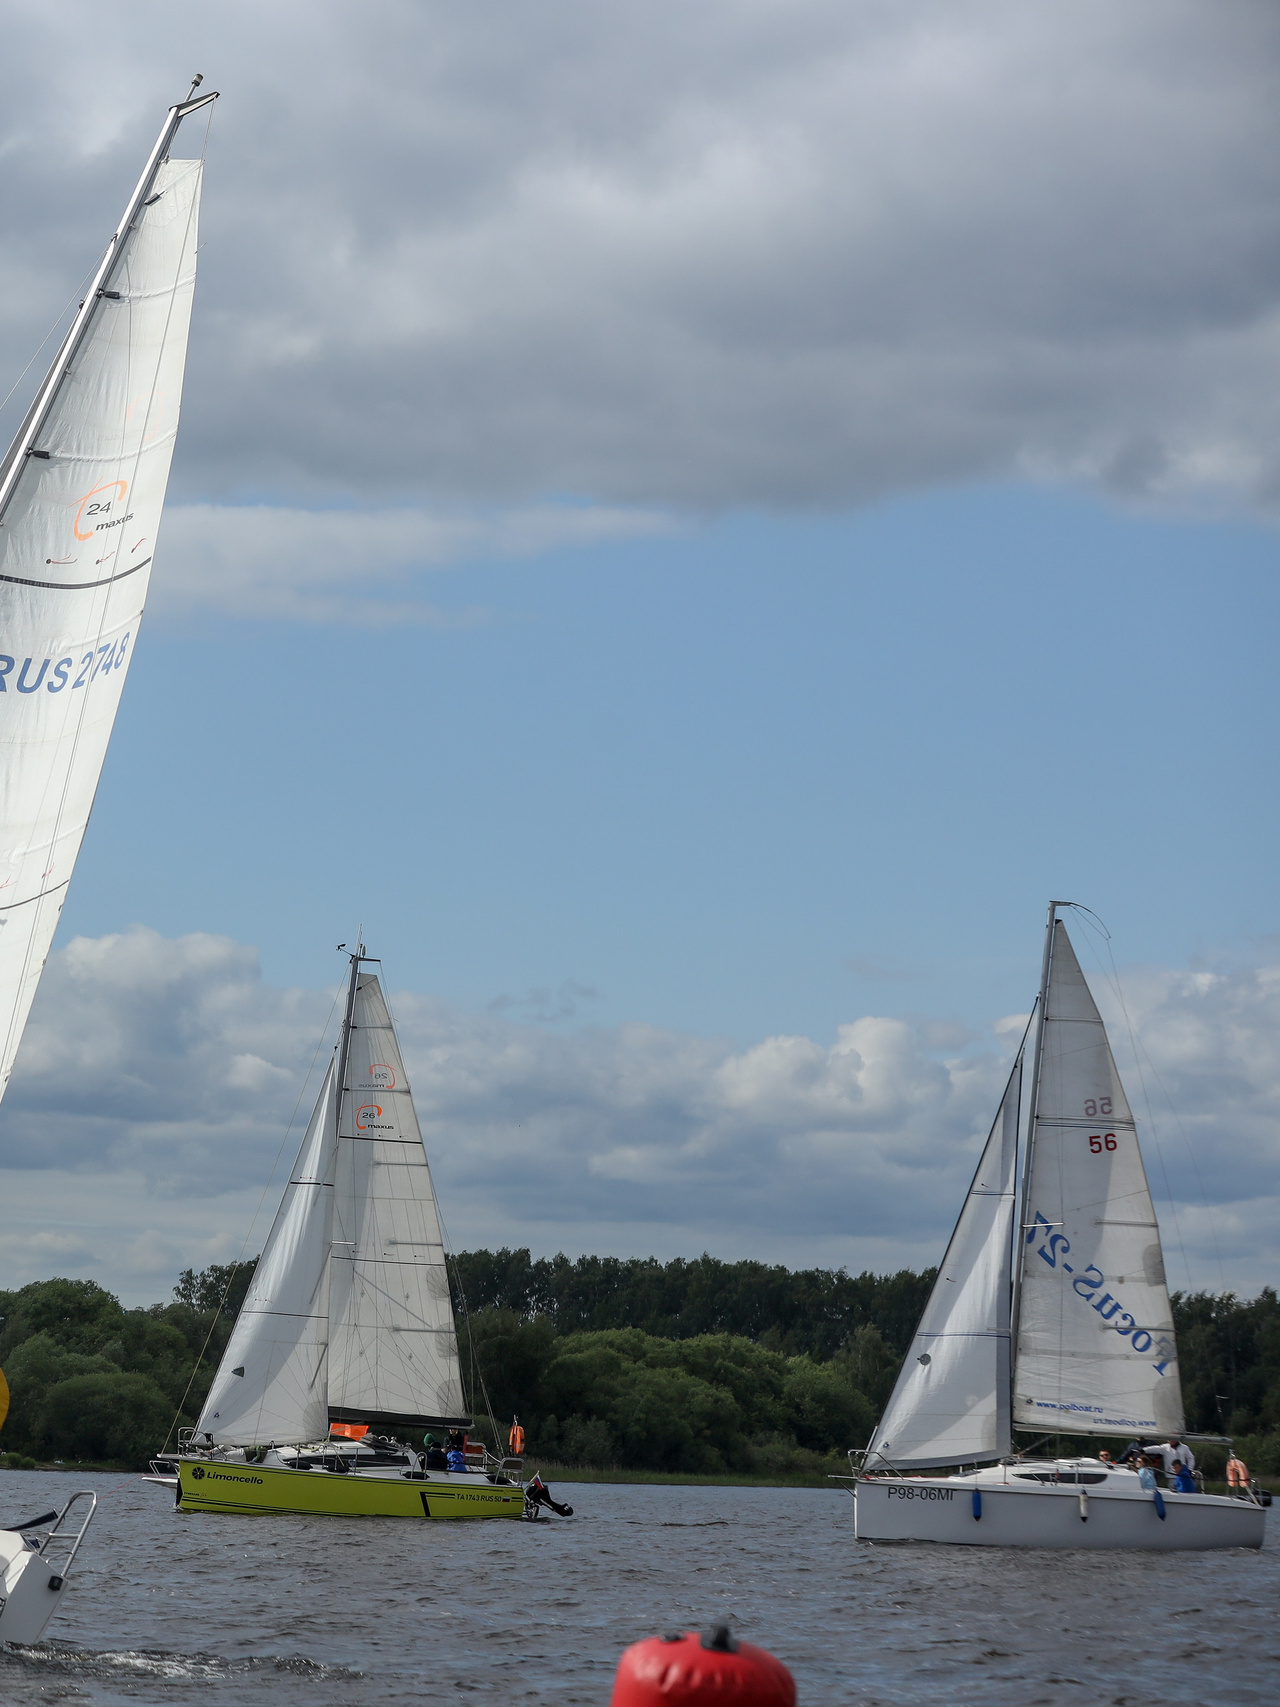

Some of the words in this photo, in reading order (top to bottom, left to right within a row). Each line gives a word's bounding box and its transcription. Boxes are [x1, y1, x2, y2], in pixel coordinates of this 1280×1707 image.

[86, 501, 111, 516] 24
[95, 512, 134, 532] maxus
[1088, 1132, 1117, 1154] 56
[1036, 1401, 1104, 1414] www.polboat.ru
[207, 1471, 264, 1485] Limoncello
